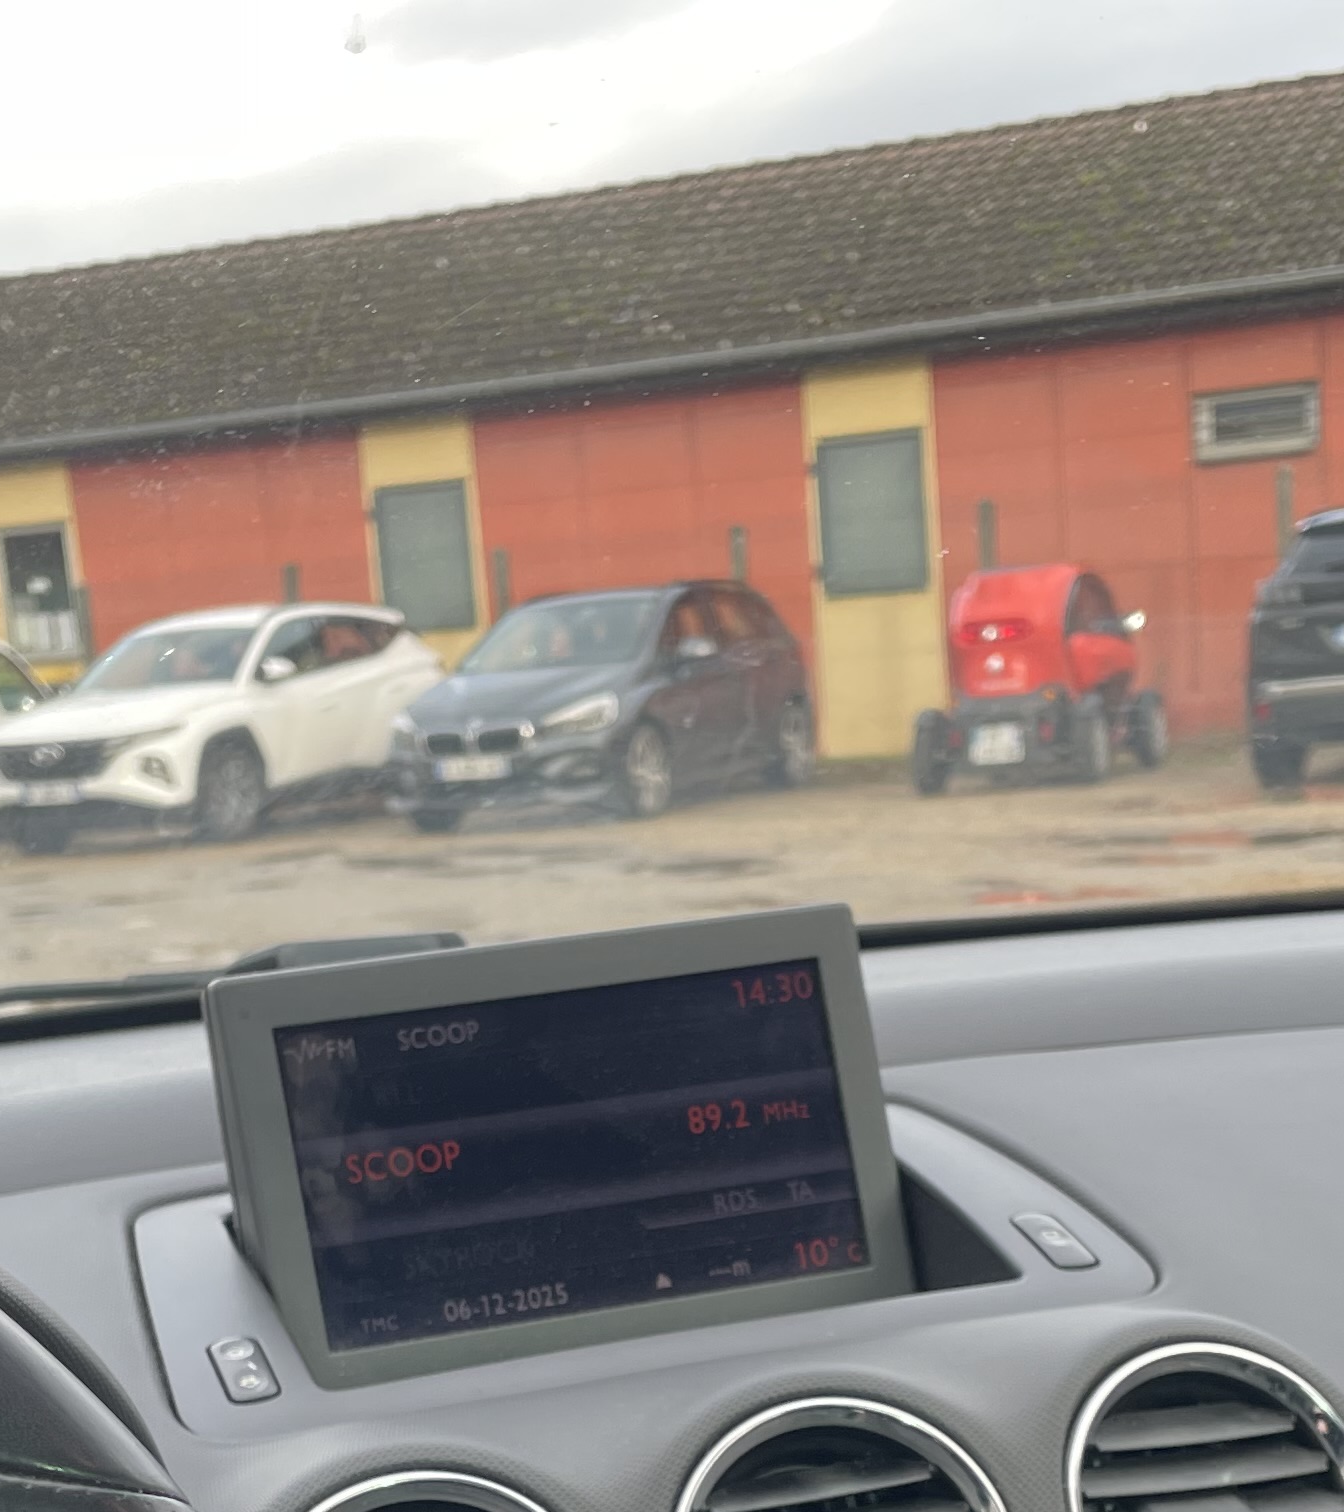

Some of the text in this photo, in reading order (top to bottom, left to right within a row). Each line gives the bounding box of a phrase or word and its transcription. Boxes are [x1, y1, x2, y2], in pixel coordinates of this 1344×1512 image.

[732, 972, 814, 1009] 14:30
[325, 1020, 481, 1060] FM SCOOP
[345, 1099, 811, 1184] SCOOP 89.2 MHz
[714, 1181, 817, 1215] RDS TA
[360, 1284, 570, 1334] TMC 06-12-2025
